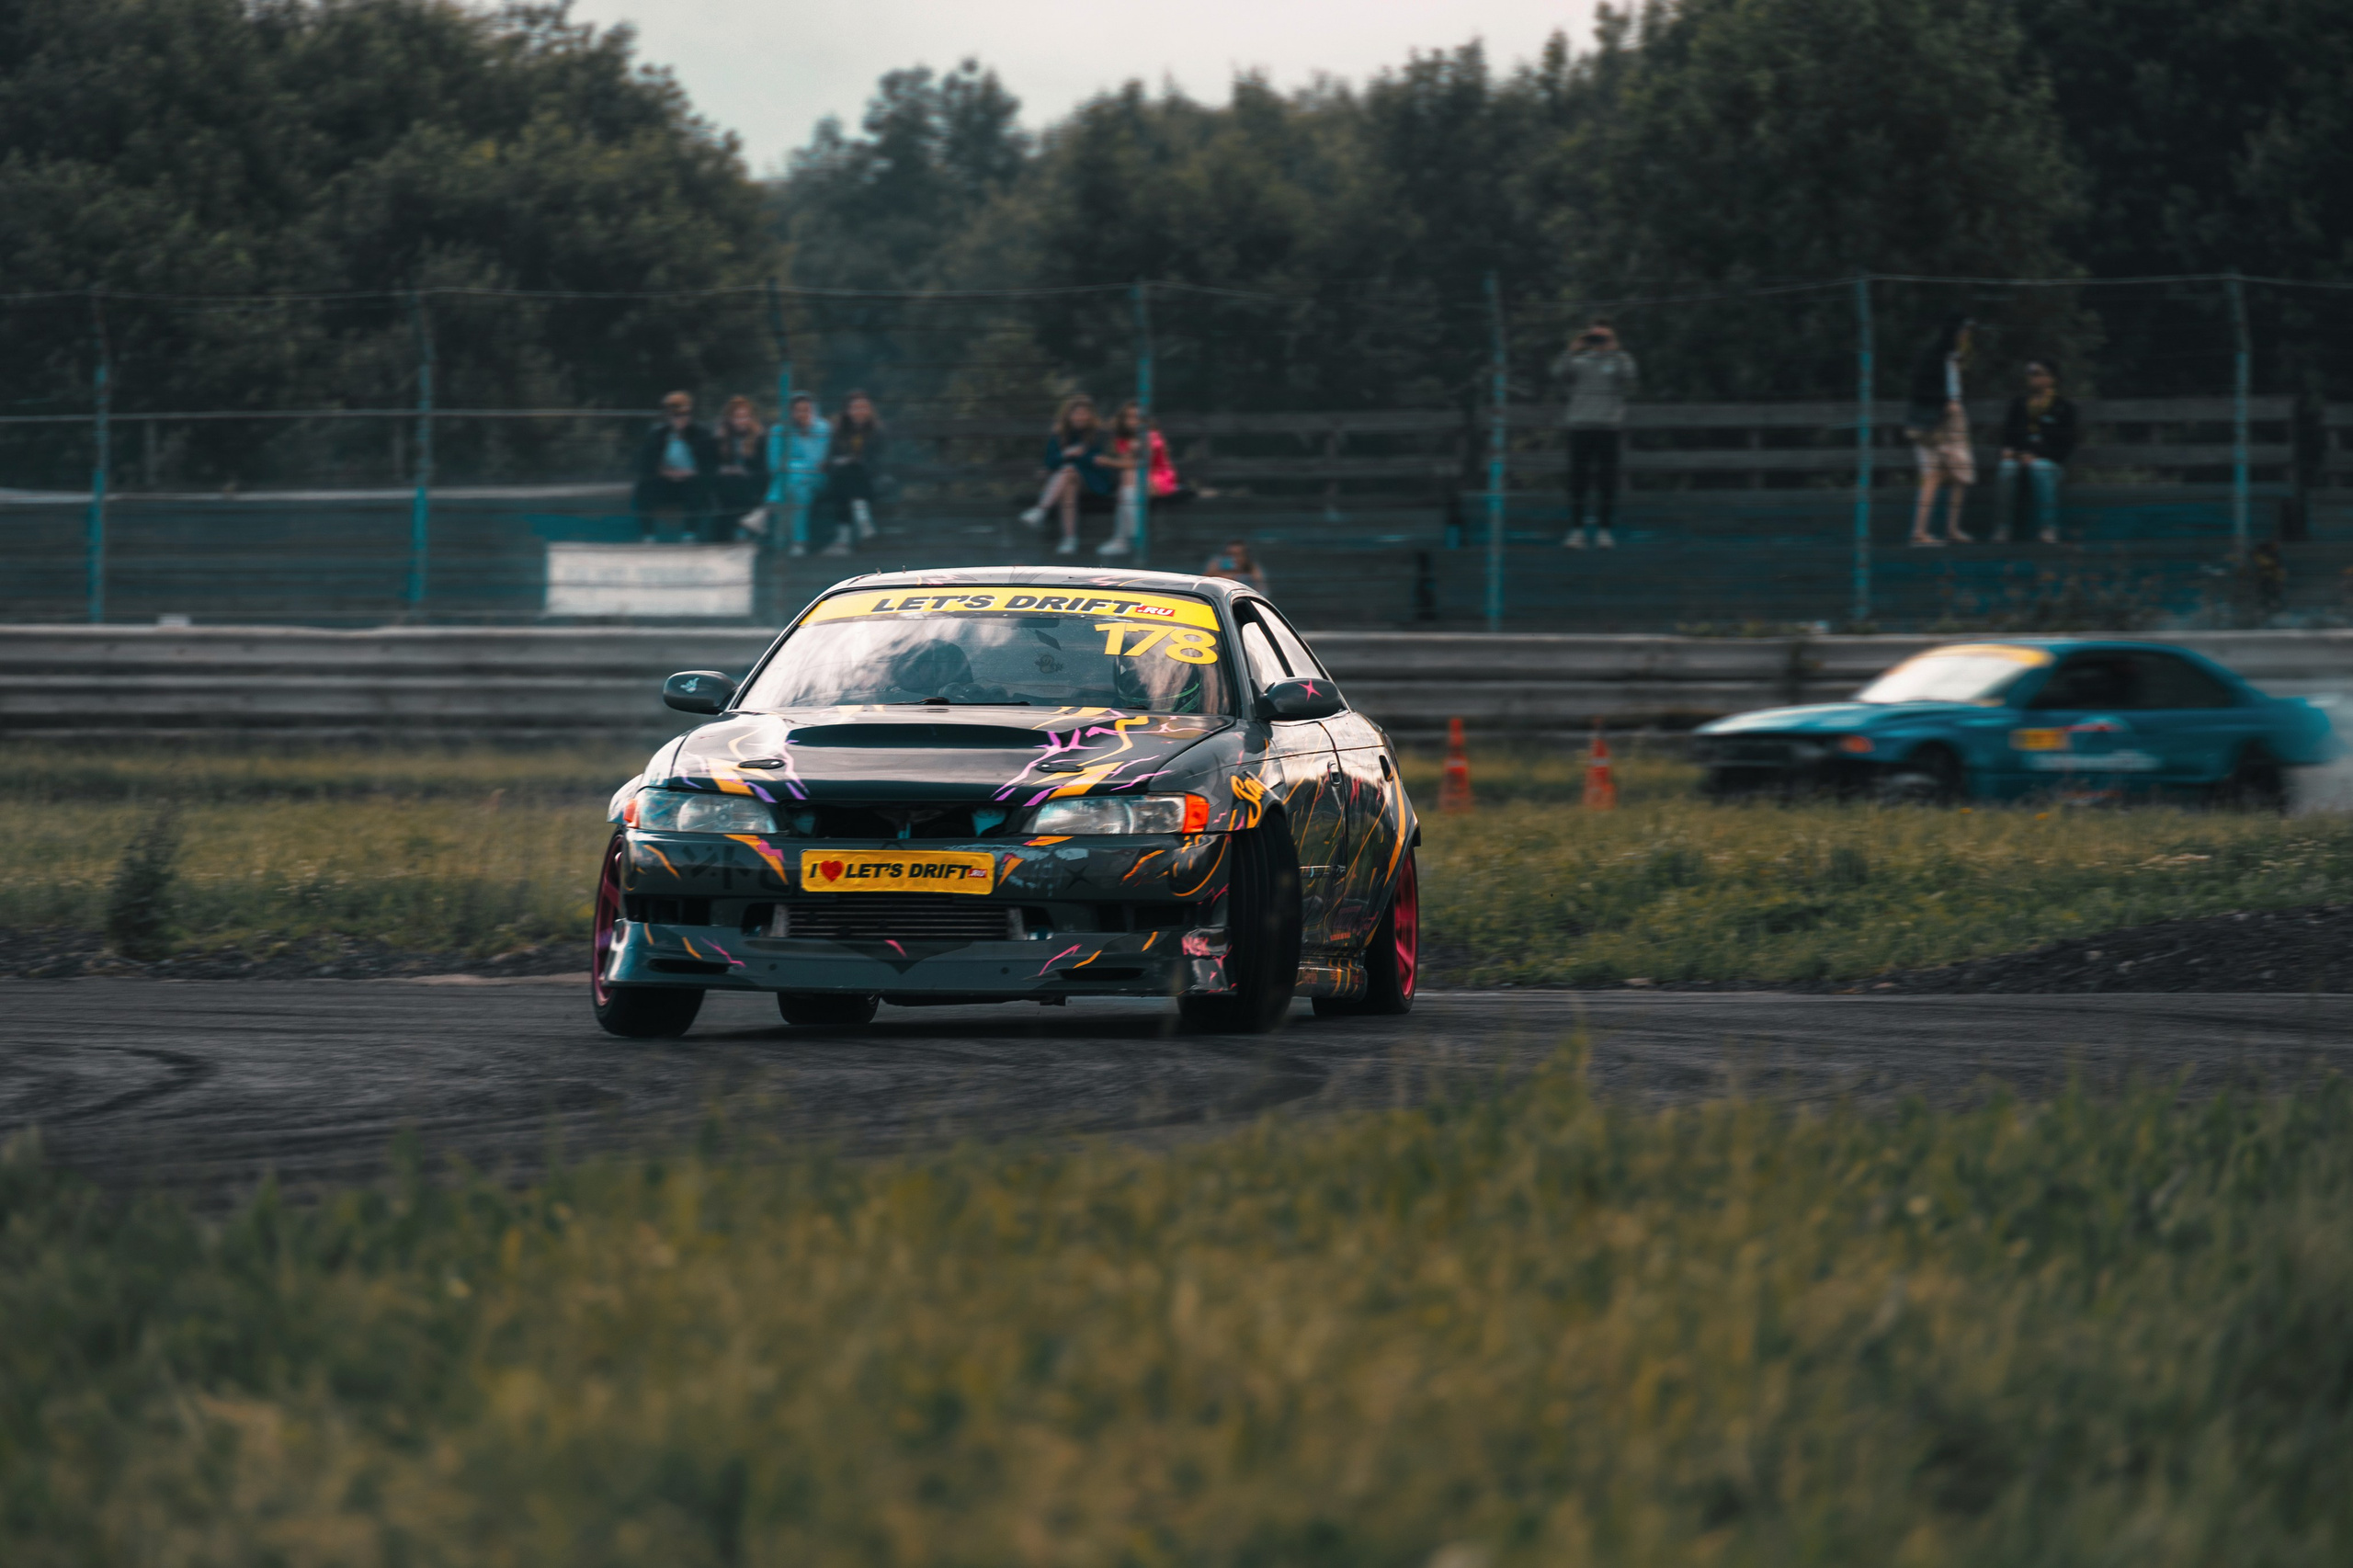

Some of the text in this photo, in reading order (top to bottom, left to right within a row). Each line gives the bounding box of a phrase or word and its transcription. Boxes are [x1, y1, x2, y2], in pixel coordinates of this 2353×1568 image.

[871, 595, 995, 612] LET'S
[1094, 621, 1218, 665] 178
[809, 863, 818, 878] I
[845, 862, 904, 879] LET'S
